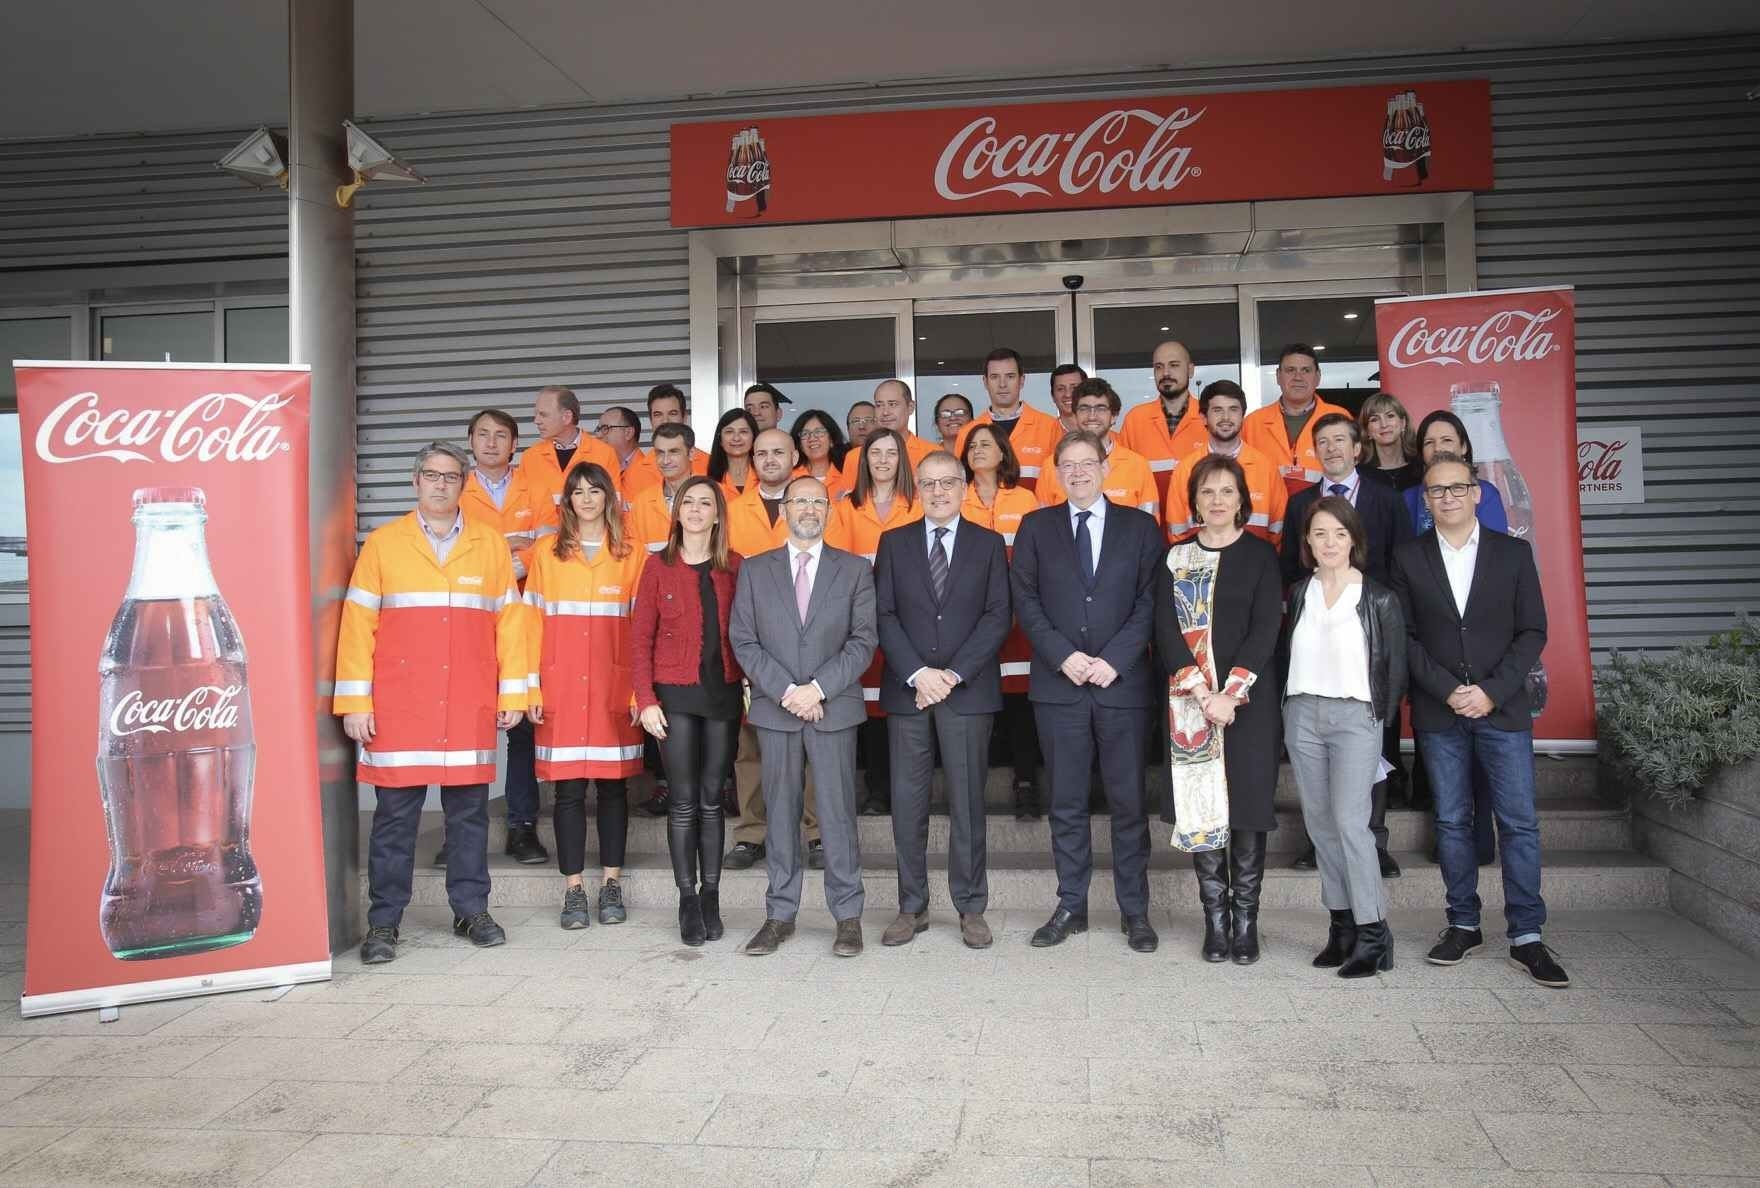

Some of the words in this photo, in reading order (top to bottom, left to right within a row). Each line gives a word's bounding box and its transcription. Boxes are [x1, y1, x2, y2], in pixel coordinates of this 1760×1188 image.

[934, 106, 1206, 200] Coca-Cola
[1388, 308, 1562, 368] Coca-Cola
[35, 391, 295, 464] Coca-Cola
[110, 685, 242, 737] Coca-Cola
